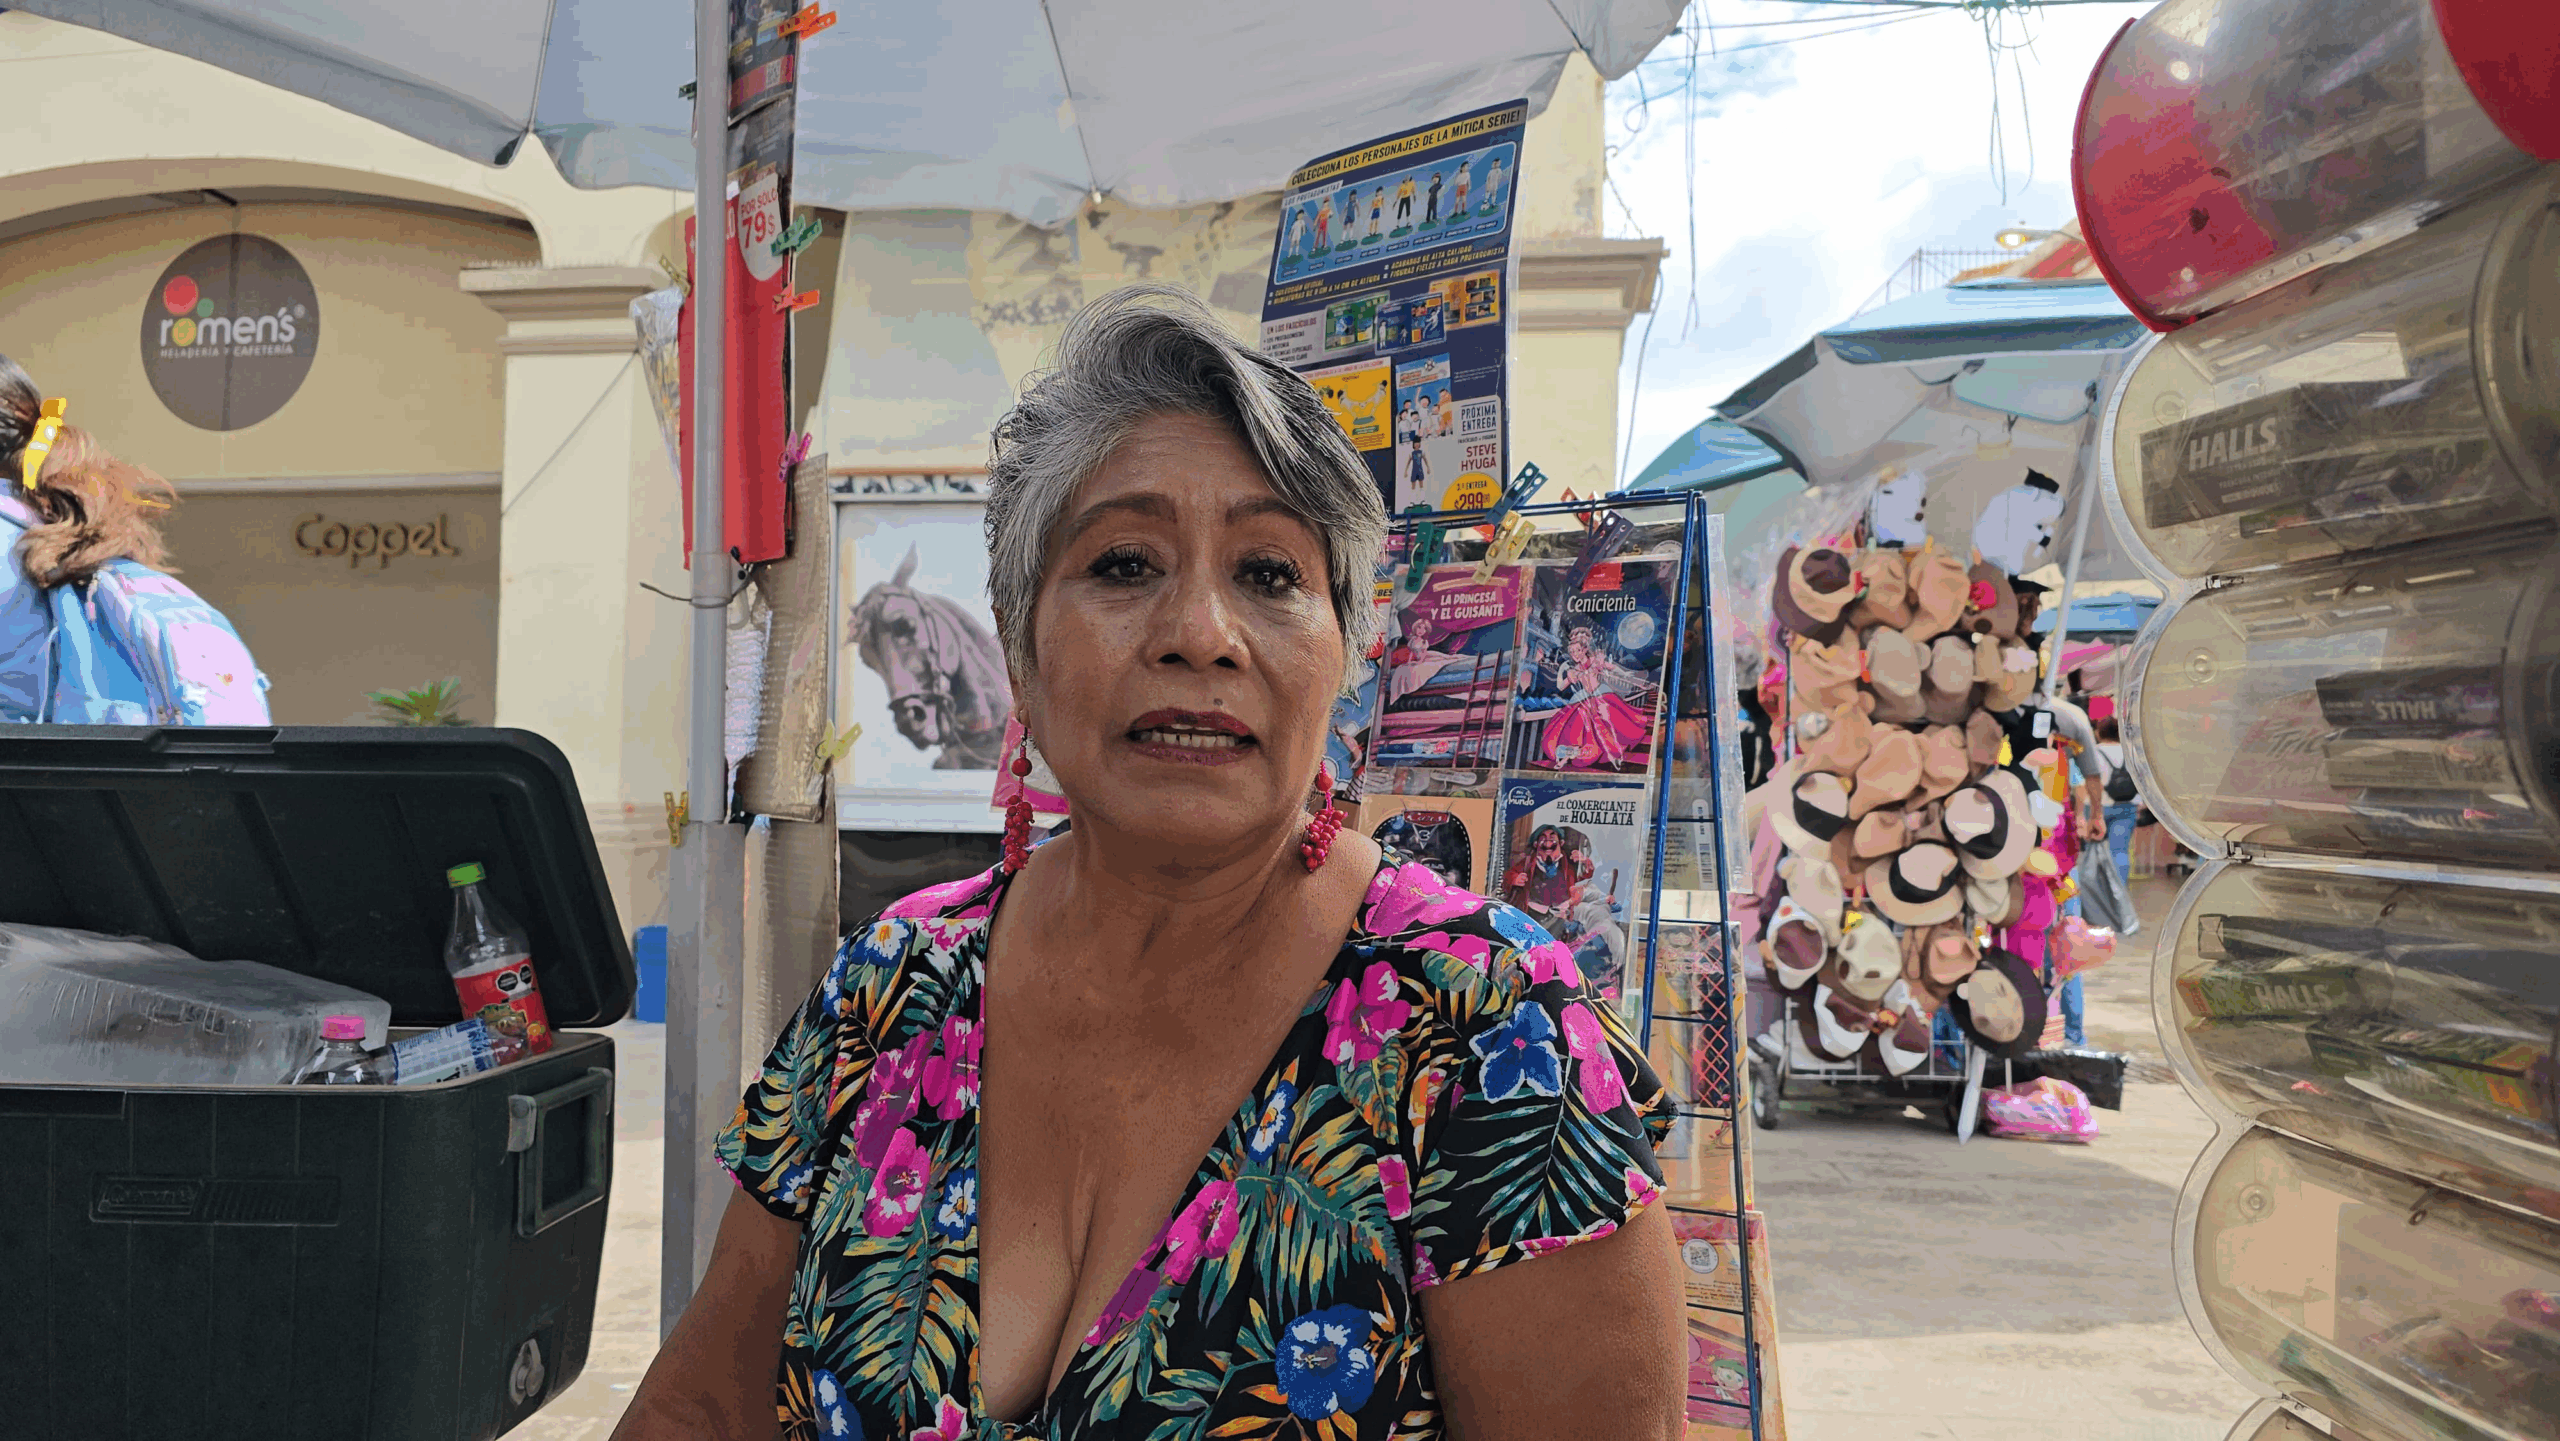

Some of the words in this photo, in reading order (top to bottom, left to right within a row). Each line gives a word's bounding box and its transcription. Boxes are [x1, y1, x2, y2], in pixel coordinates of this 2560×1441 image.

[1291, 159, 1341, 186] COLECCIONA
[1343, 154, 1360, 169] LOS
[1361, 137, 1420, 164] PERSONAJES
[1422, 132, 1435, 147] DE
[1437, 128, 1449, 143] LA
[1451, 118, 1485, 139] MÍTICA
[1487, 109, 1521, 129] SERIE!
[1415, 261, 1437, 274] FIELES
[1459, 246, 1506, 264] PROTAGONISTA
[1461, 404, 1497, 421] PRÓXIMA
[1462, 416, 1497, 432] ENTREGA
[1466, 443, 1497, 458] STEVE
[2188, 416, 2278, 473] HALLS
[1461, 457, 1497, 472] HYUGA
[1465, 480, 1488, 491] ENTREGA
[295, 512, 462, 570] Coppel
[1440, 593, 1452, 607] LA
[1453, 590, 1497, 606] PRINCESA
[1566, 593, 1637, 614] Cenicienta
[1430, 607, 1440, 621] Y
[1440, 606, 1452, 620] EL
[1454, 603, 1505, 619] GUISANTE
[1508, 798, 1535, 807] Mundo
[1556, 801, 1566, 810] EL
[1566, 799, 1637, 813] COMERCIANTE
[1559, 815, 1569, 823] DE
[1569, 811, 1635, 826] HOJALATA
[1418, 829, 1431, 842] 3
[2254, 984, 2334, 1010] HALLS
